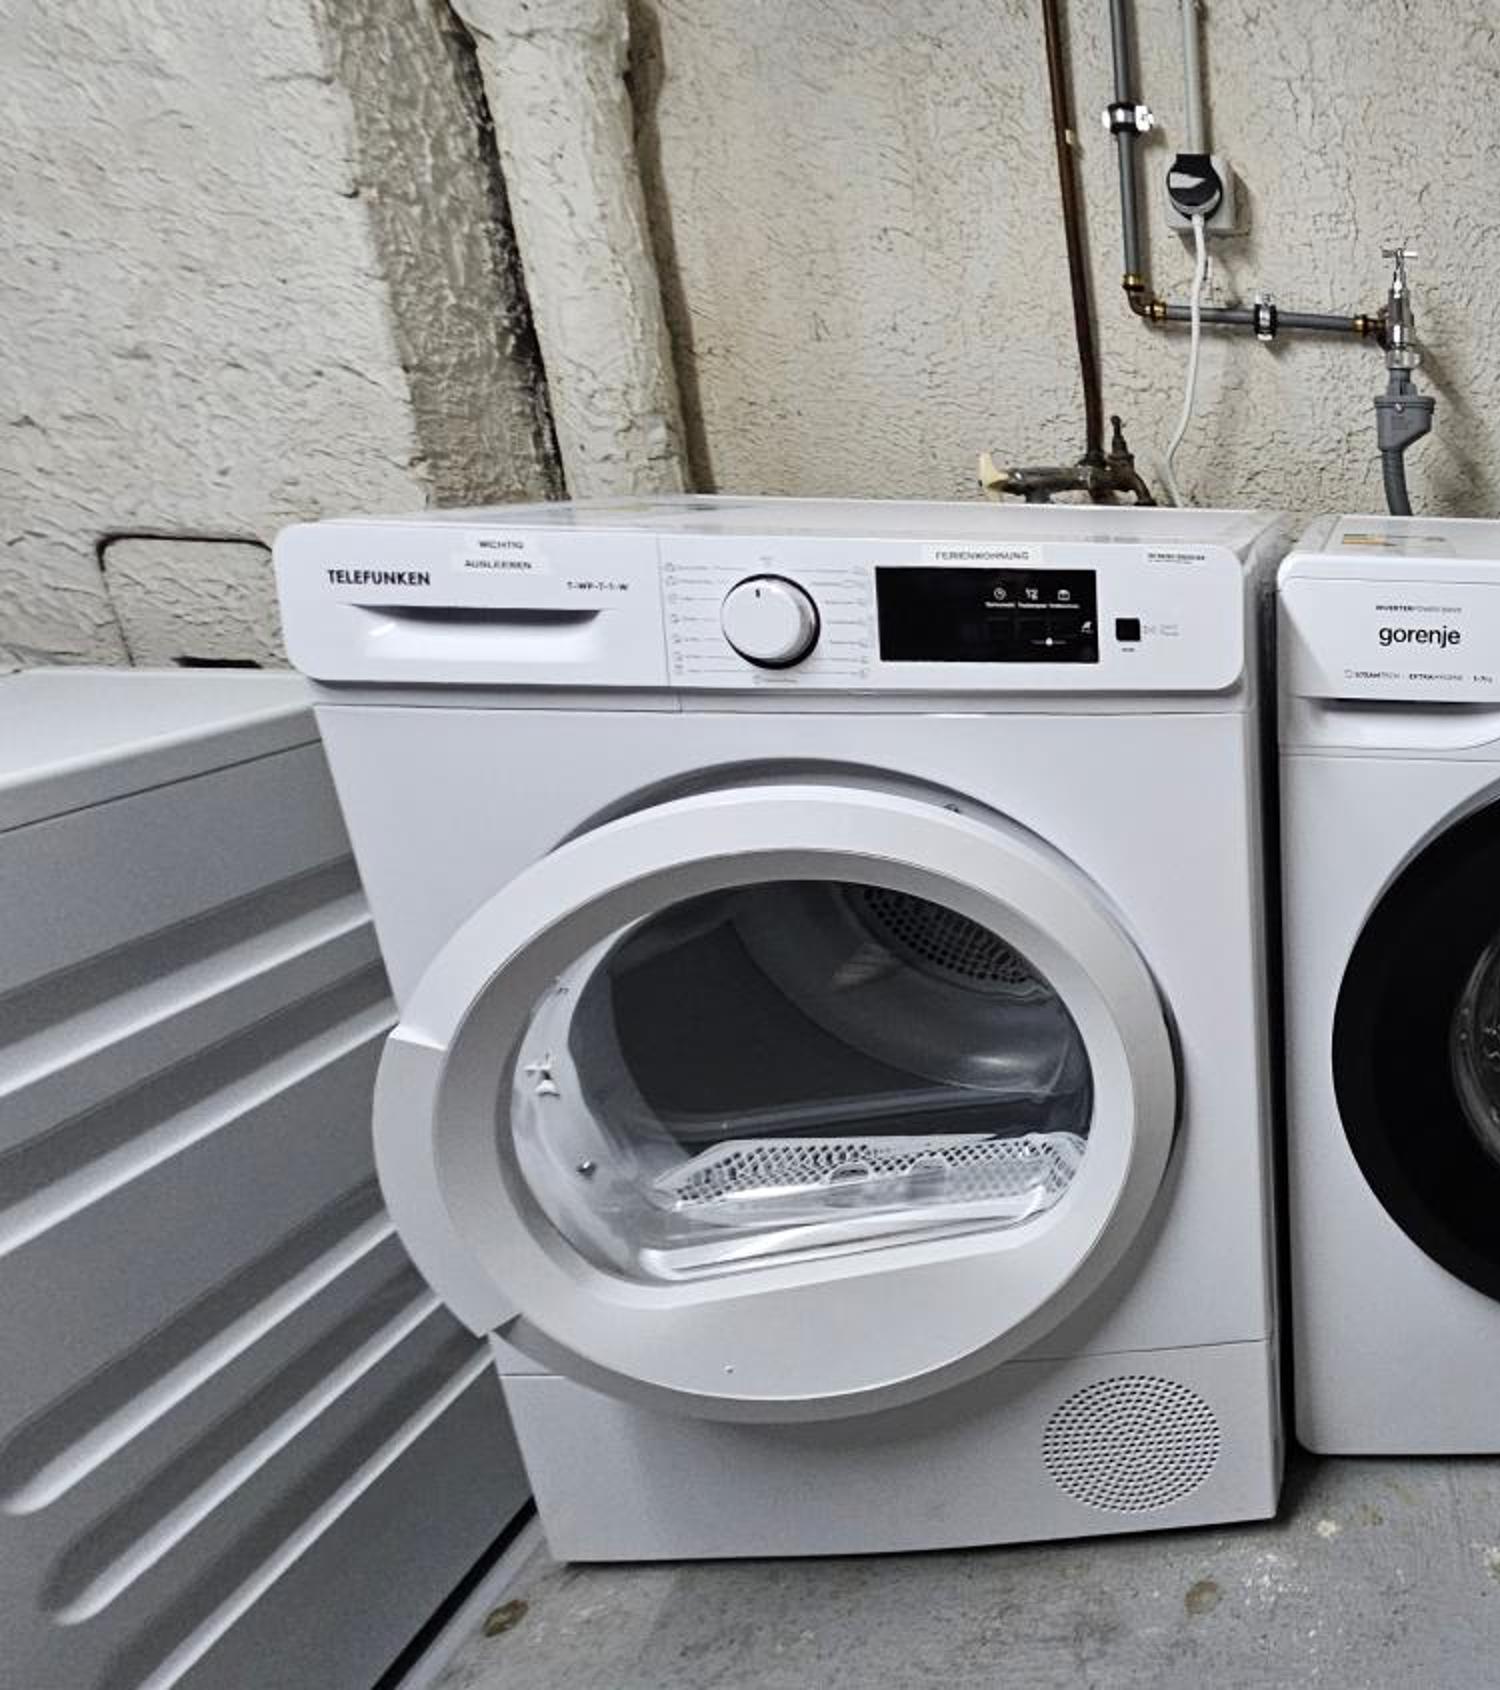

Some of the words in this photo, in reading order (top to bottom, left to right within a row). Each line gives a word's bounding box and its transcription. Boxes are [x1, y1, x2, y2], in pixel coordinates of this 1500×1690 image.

[478, 541, 524, 549] WICHTIG
[935, 551, 1029, 561] FERIENWOHNUNG
[328, 569, 431, 586] TELEFUNKEN
[1378, 625, 1462, 649] gorenje
